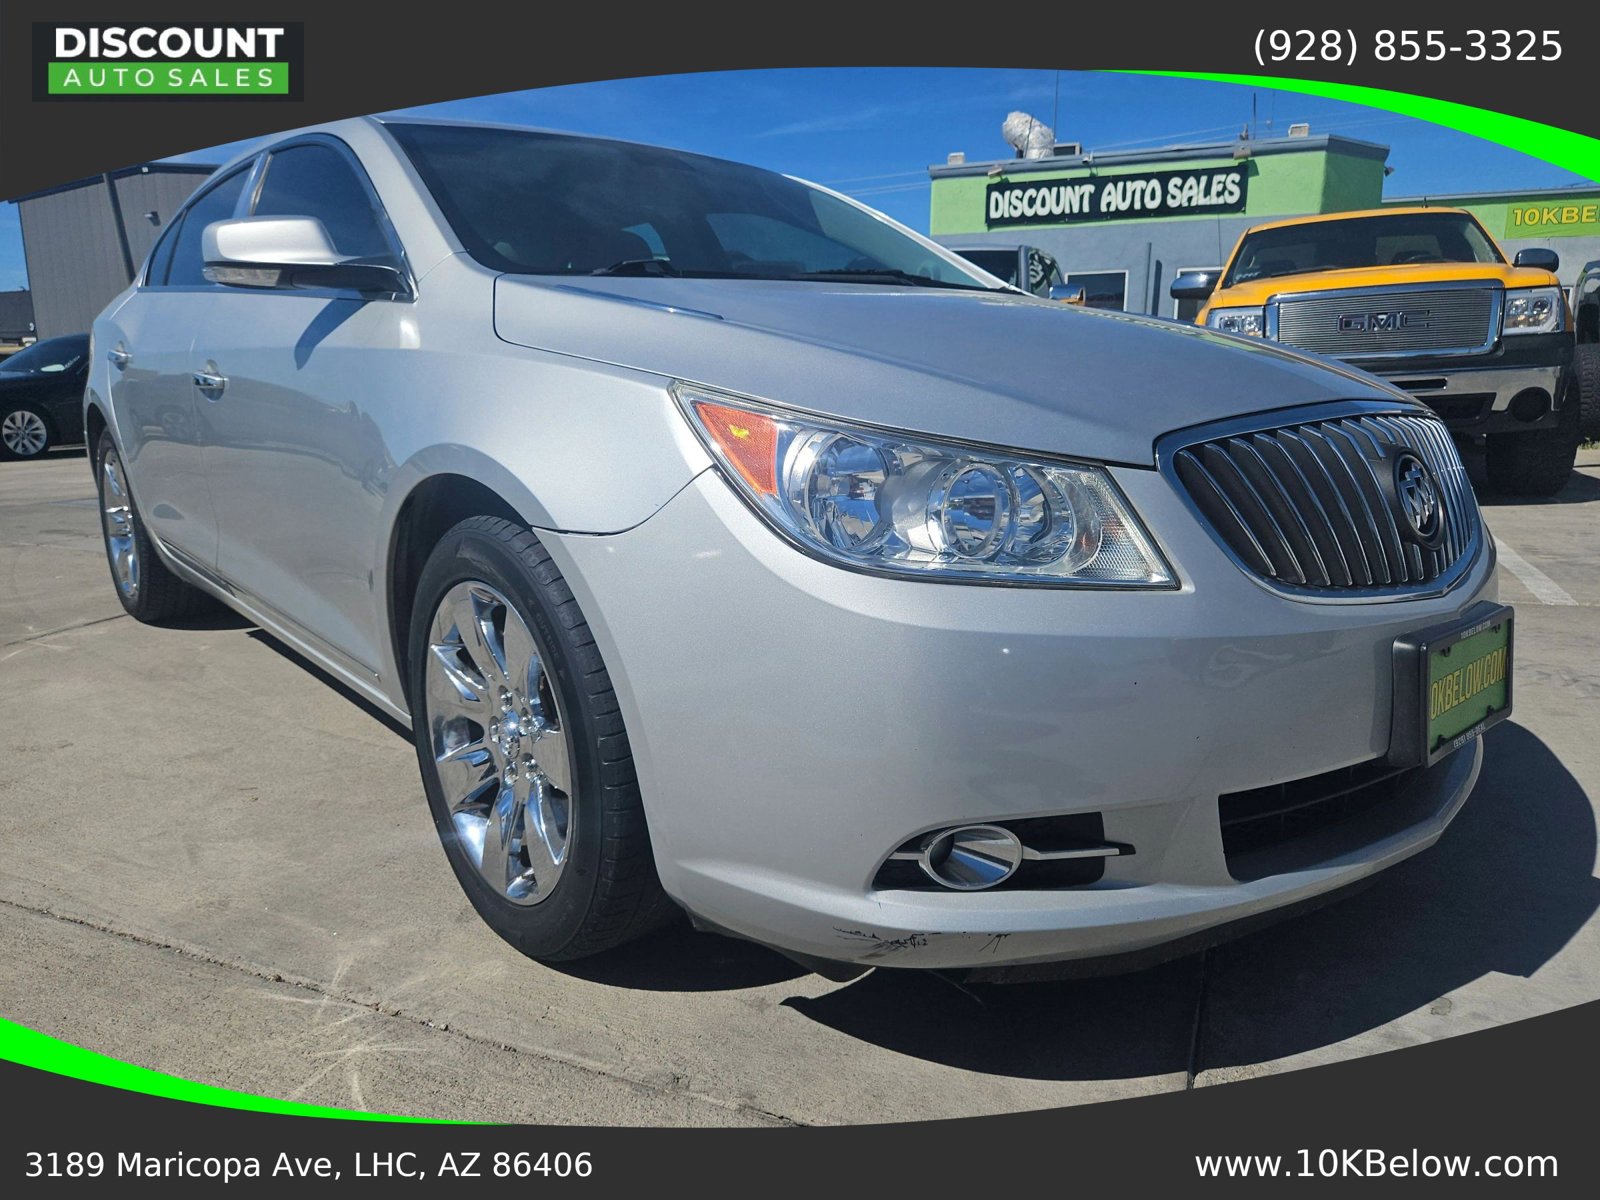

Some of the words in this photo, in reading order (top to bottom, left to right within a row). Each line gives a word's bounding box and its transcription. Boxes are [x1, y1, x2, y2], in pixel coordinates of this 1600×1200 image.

[989, 184, 1095, 219] DISCOUNT
[1100, 178, 1162, 213] AUTO
[1166, 173, 1241, 208] SALES
[1337, 309, 1430, 334] GMC
